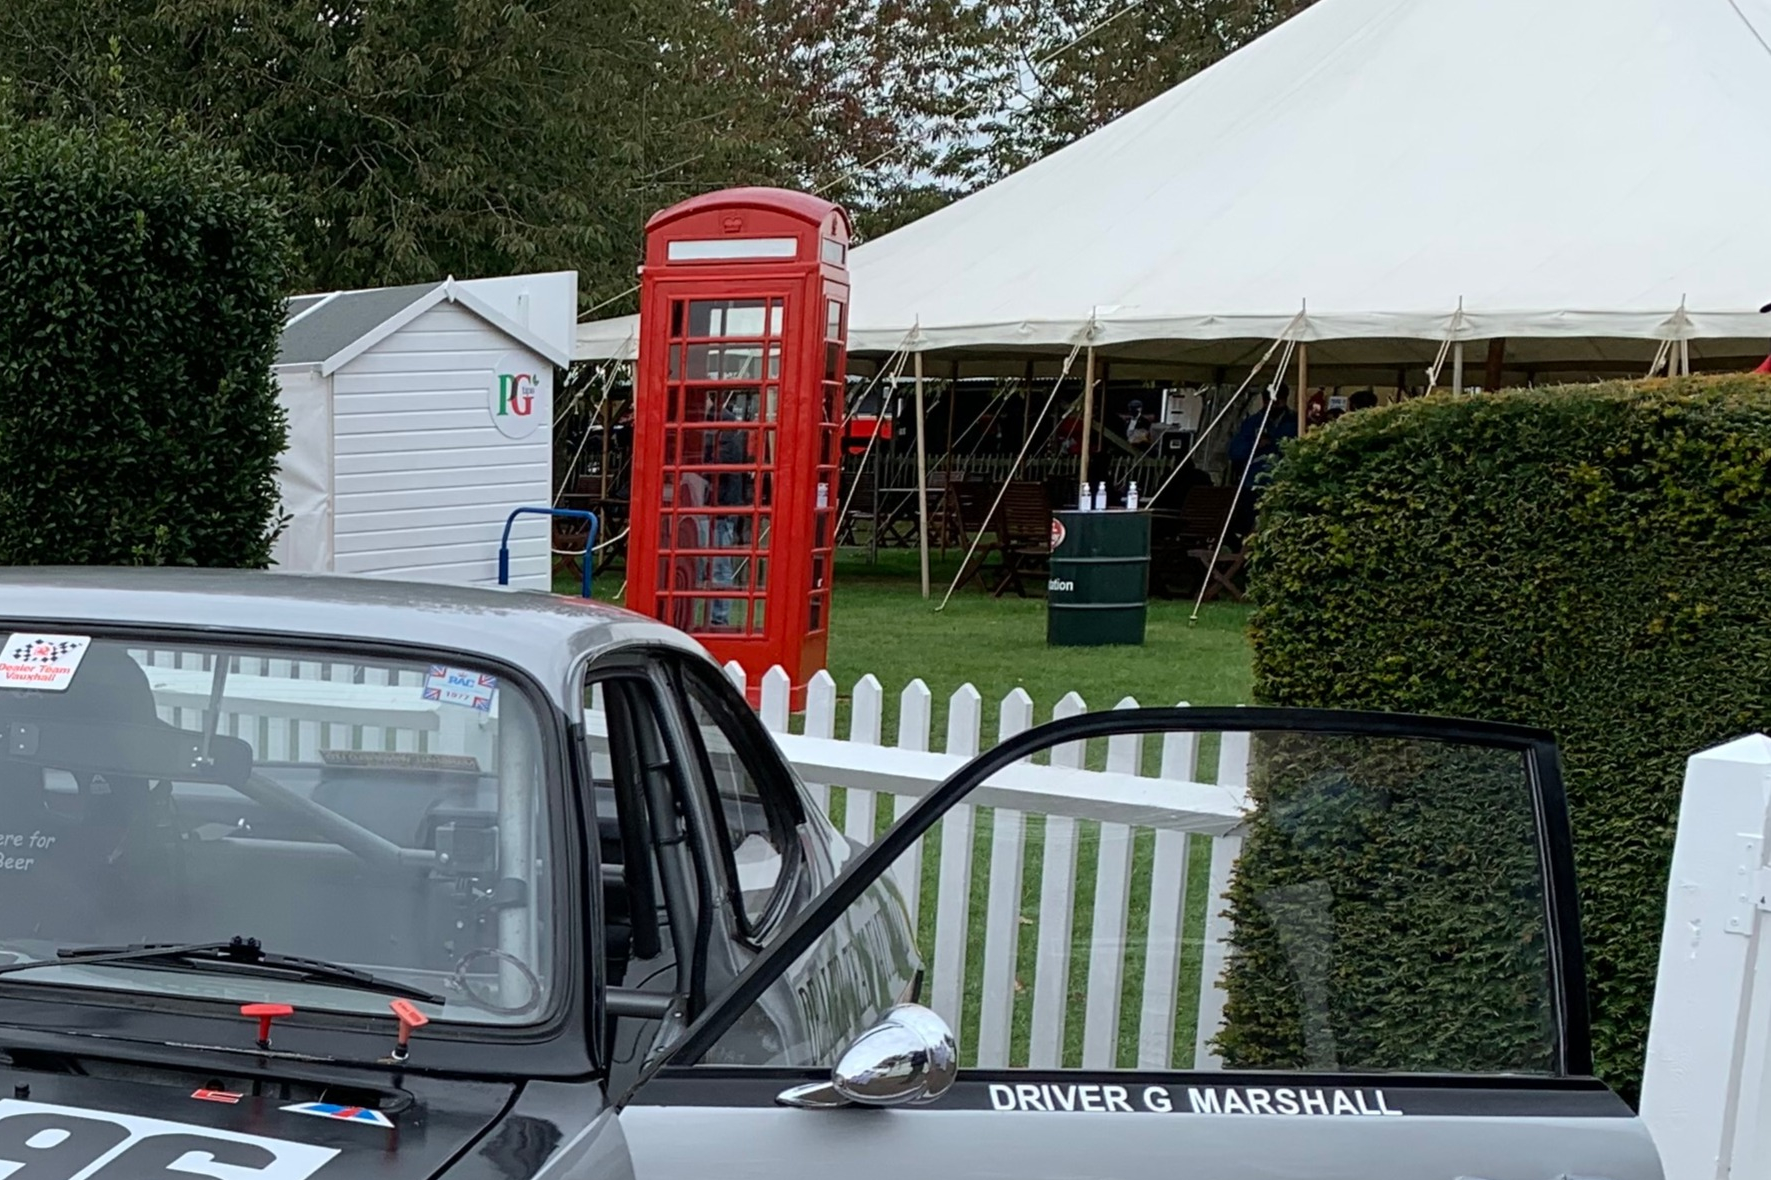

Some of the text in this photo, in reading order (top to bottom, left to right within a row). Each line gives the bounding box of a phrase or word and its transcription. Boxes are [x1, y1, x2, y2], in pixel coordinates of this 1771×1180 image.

[497, 374, 534, 416] PG
[39, 663, 71, 674] Team
[5, 672, 56, 683] Vauxhall
[447, 674, 476, 688] RAC
[445, 690, 471, 701] 1977
[29, 830, 56, 849] for
[988, 1083, 1403, 1116] DRIVER G MARSHALL
